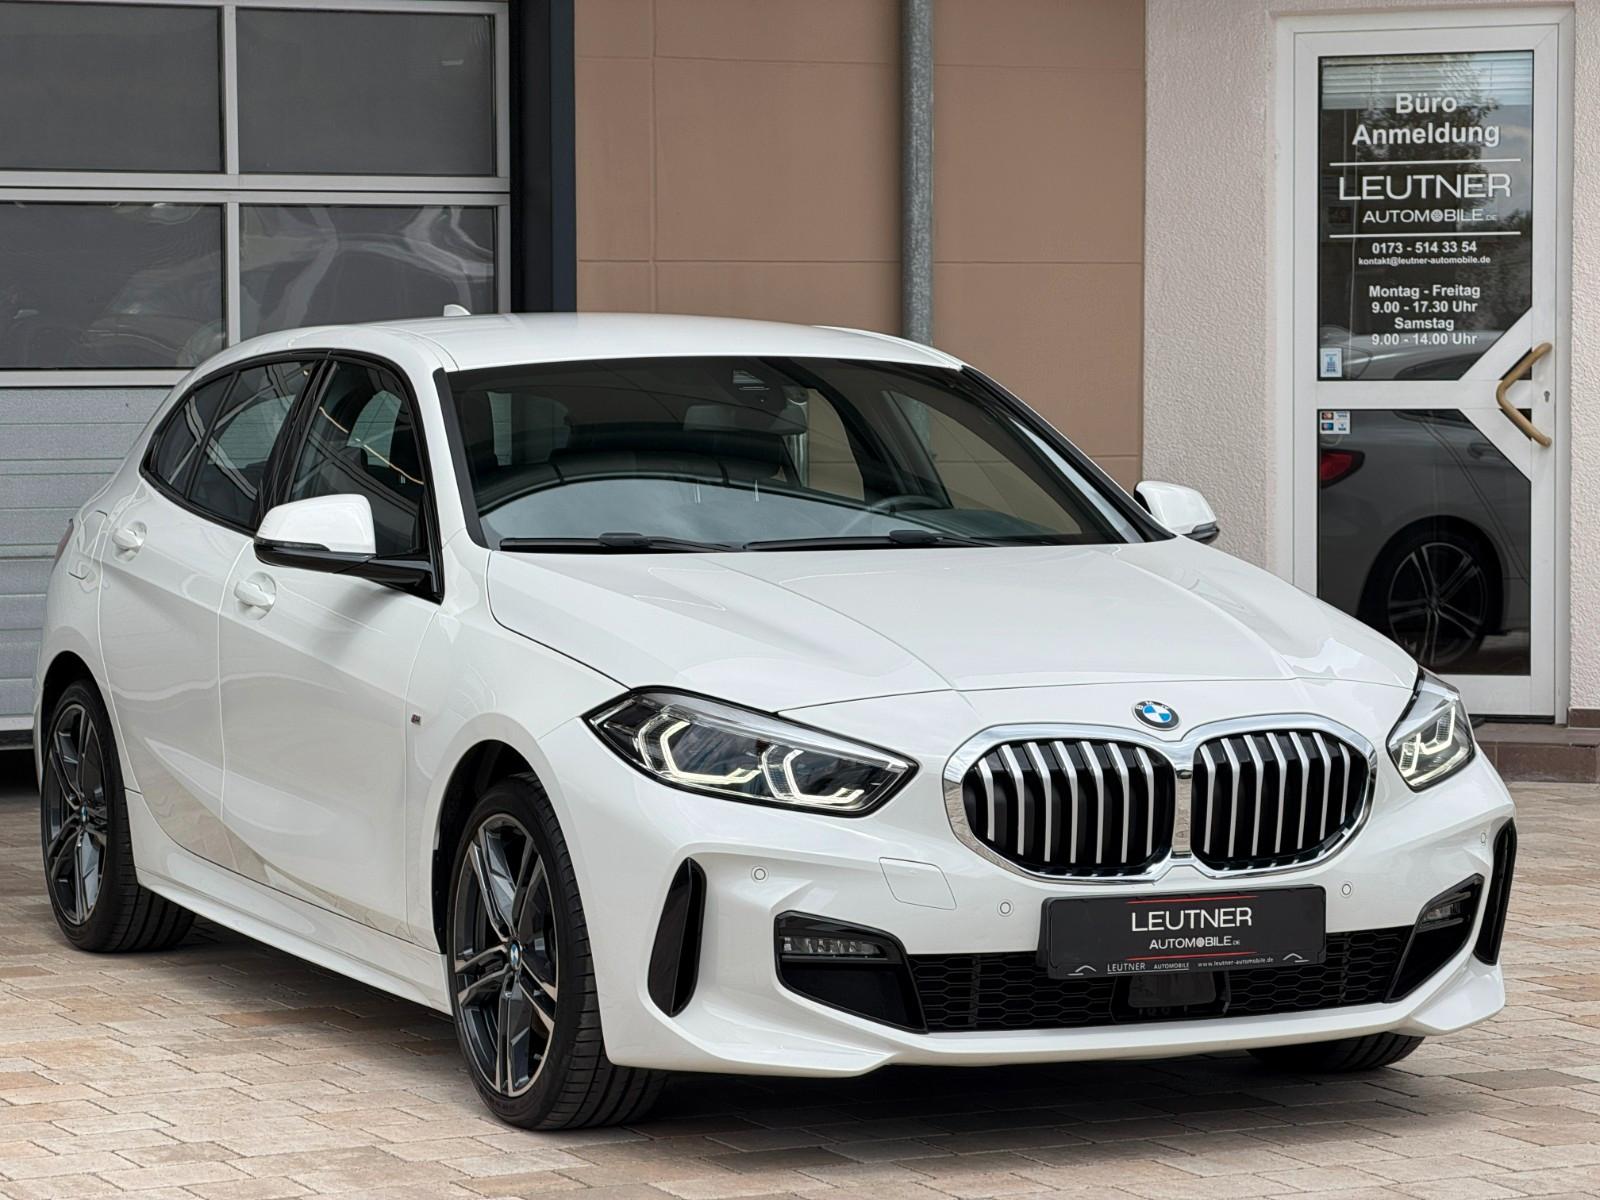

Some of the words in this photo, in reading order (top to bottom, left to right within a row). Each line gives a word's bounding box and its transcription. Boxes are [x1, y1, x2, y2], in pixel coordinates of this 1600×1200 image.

[1395, 92, 1458, 114] Büro
[1352, 122, 1500, 148] Anmeldung
[1339, 173, 1512, 201] LEUTNER
[1371, 242, 1403, 254] 0173
[1415, 241, 1439, 253] 514
[1442, 241, 1458, 253] 33
[1461, 240, 1477, 253] 54
[1358, 256, 1491, 267] kontakt@leutner-automobile.de
[1369, 285, 1420, 299] Montag
[1432, 284, 1481, 299] Freitag
[1371, 301, 1400, 313] 9.00
[1412, 301, 1448, 313] 17.30
[1452, 300, 1478, 313] Uhr
[1394, 317, 1455, 331] Samstag
[1371, 333, 1400, 345] 9.00
[1412, 333, 1448, 345] 14.00
[1452, 332, 1478, 345] Uhr
[1131, 906, 1253, 932] LEUTNER
[1107, 962, 1146, 972] LEUTNER
[1153, 962, 1190, 970] AUTOMOBILE
[1198, 957, 1274, 967] www.leutner-automobile.de
